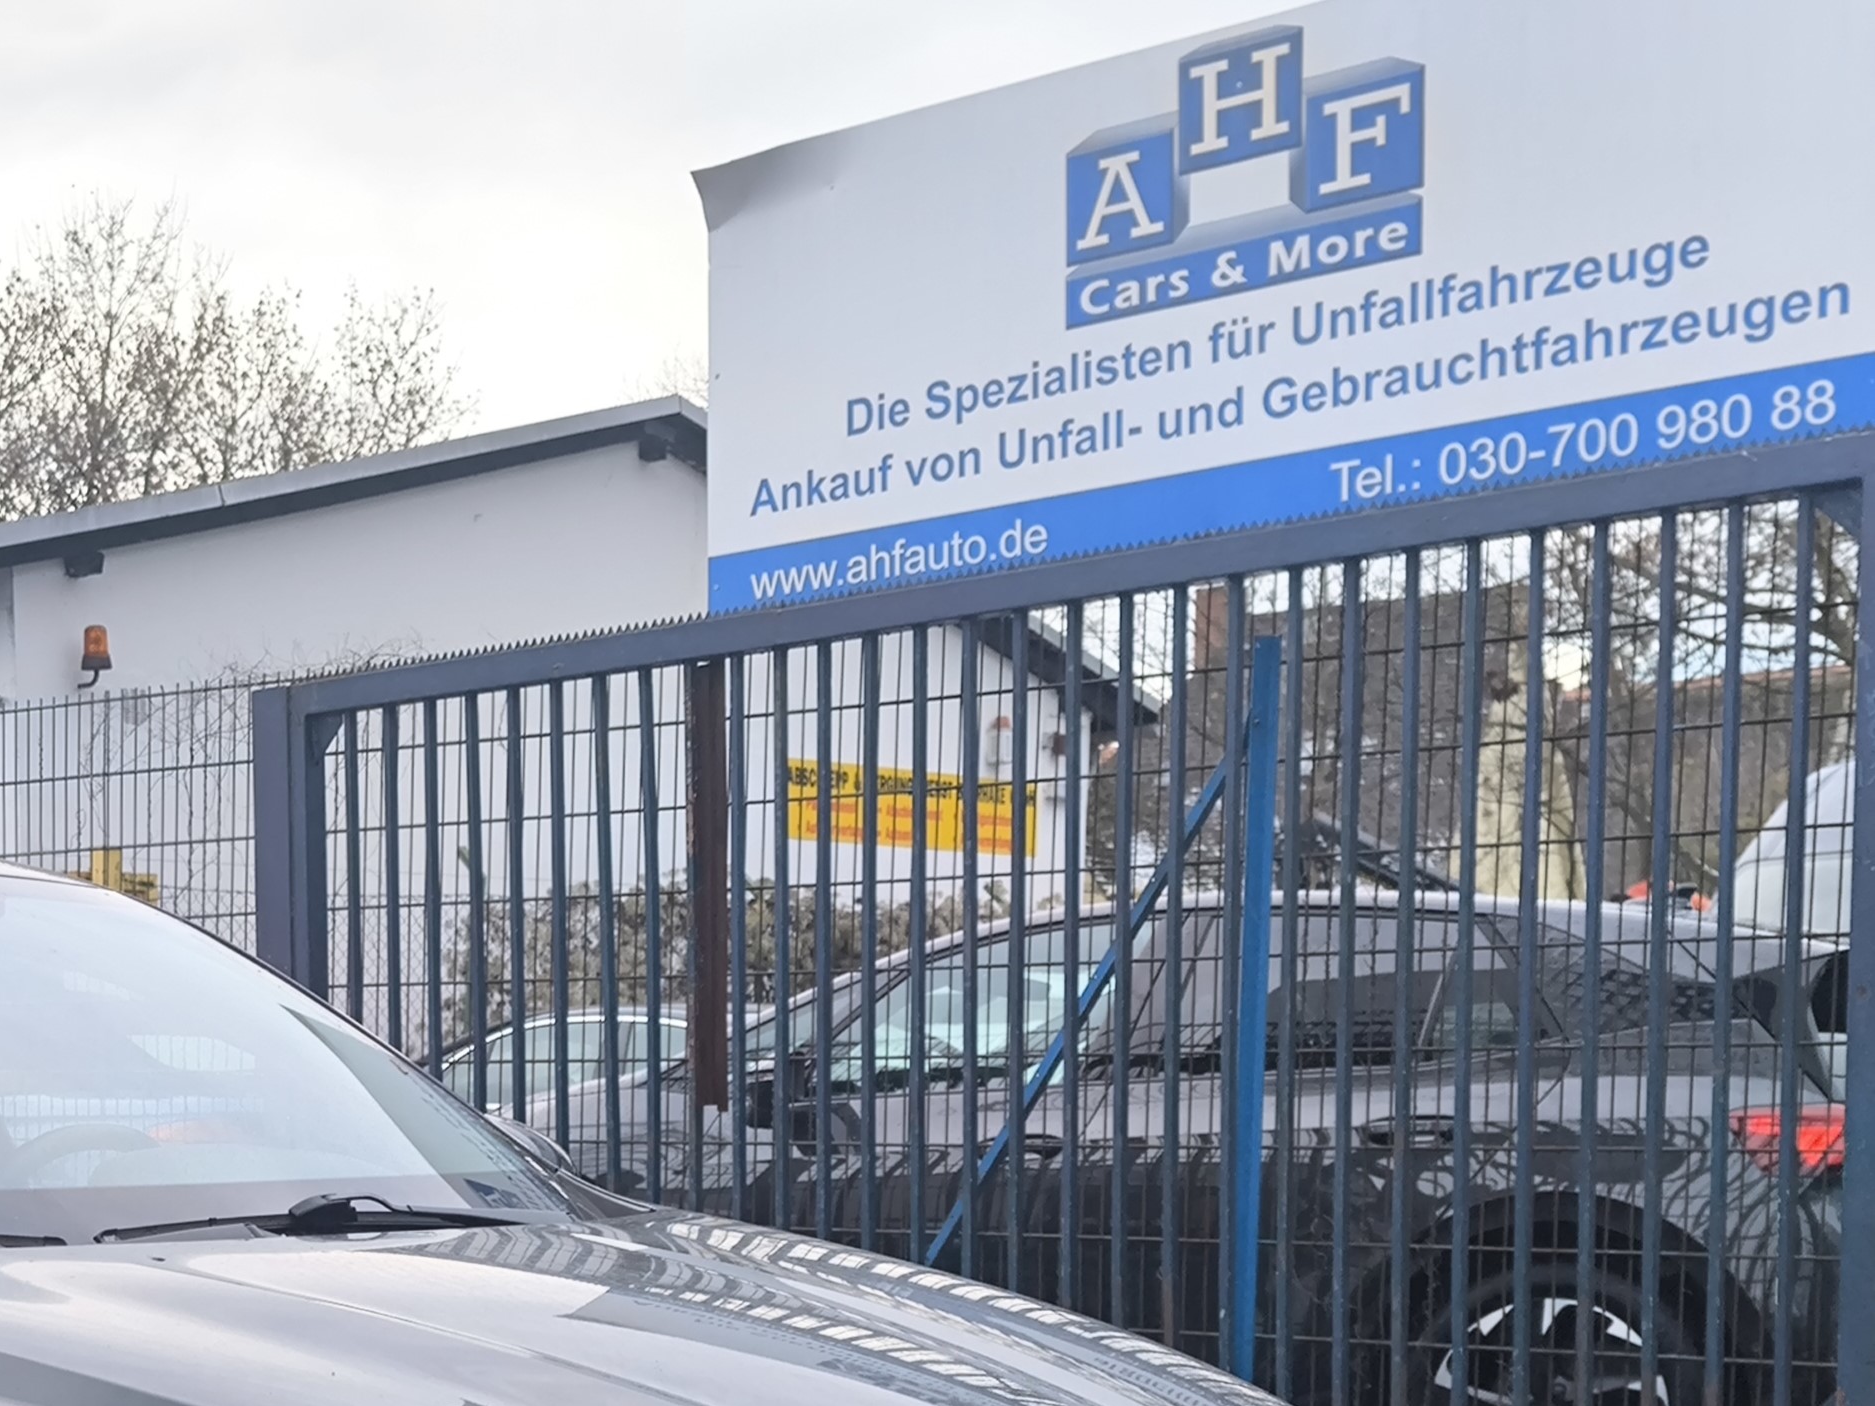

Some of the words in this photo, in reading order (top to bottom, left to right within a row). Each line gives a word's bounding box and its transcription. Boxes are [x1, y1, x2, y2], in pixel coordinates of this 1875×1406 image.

[1076, 42, 1411, 251] AHF
[1079, 269, 1190, 315] Cars
[1210, 250, 1248, 288] &
[1267, 221, 1409, 277] More
[845, 392, 911, 437] Die
[925, 337, 1192, 425] Spezialisten
[1208, 316, 1276, 364] für
[1291, 234, 1711, 346] Unfallfahrzeuge
[749, 453, 894, 517] Ankauf
[904, 446, 982, 486] von
[998, 409, 1143, 470] Unfall-
[1158, 386, 1244, 440] und
[1261, 281, 1852, 420] Gebrauchtfahrzeugen
[1330, 455, 1422, 502] Tel.:
[1437, 412, 1639, 486] 030-700
[1656, 394, 1753, 450] 980
[1771, 379, 1838, 431] 88
[749, 518, 1049, 601] www.ahfauto.de
[786, 766, 849, 790] ABSCEPP
